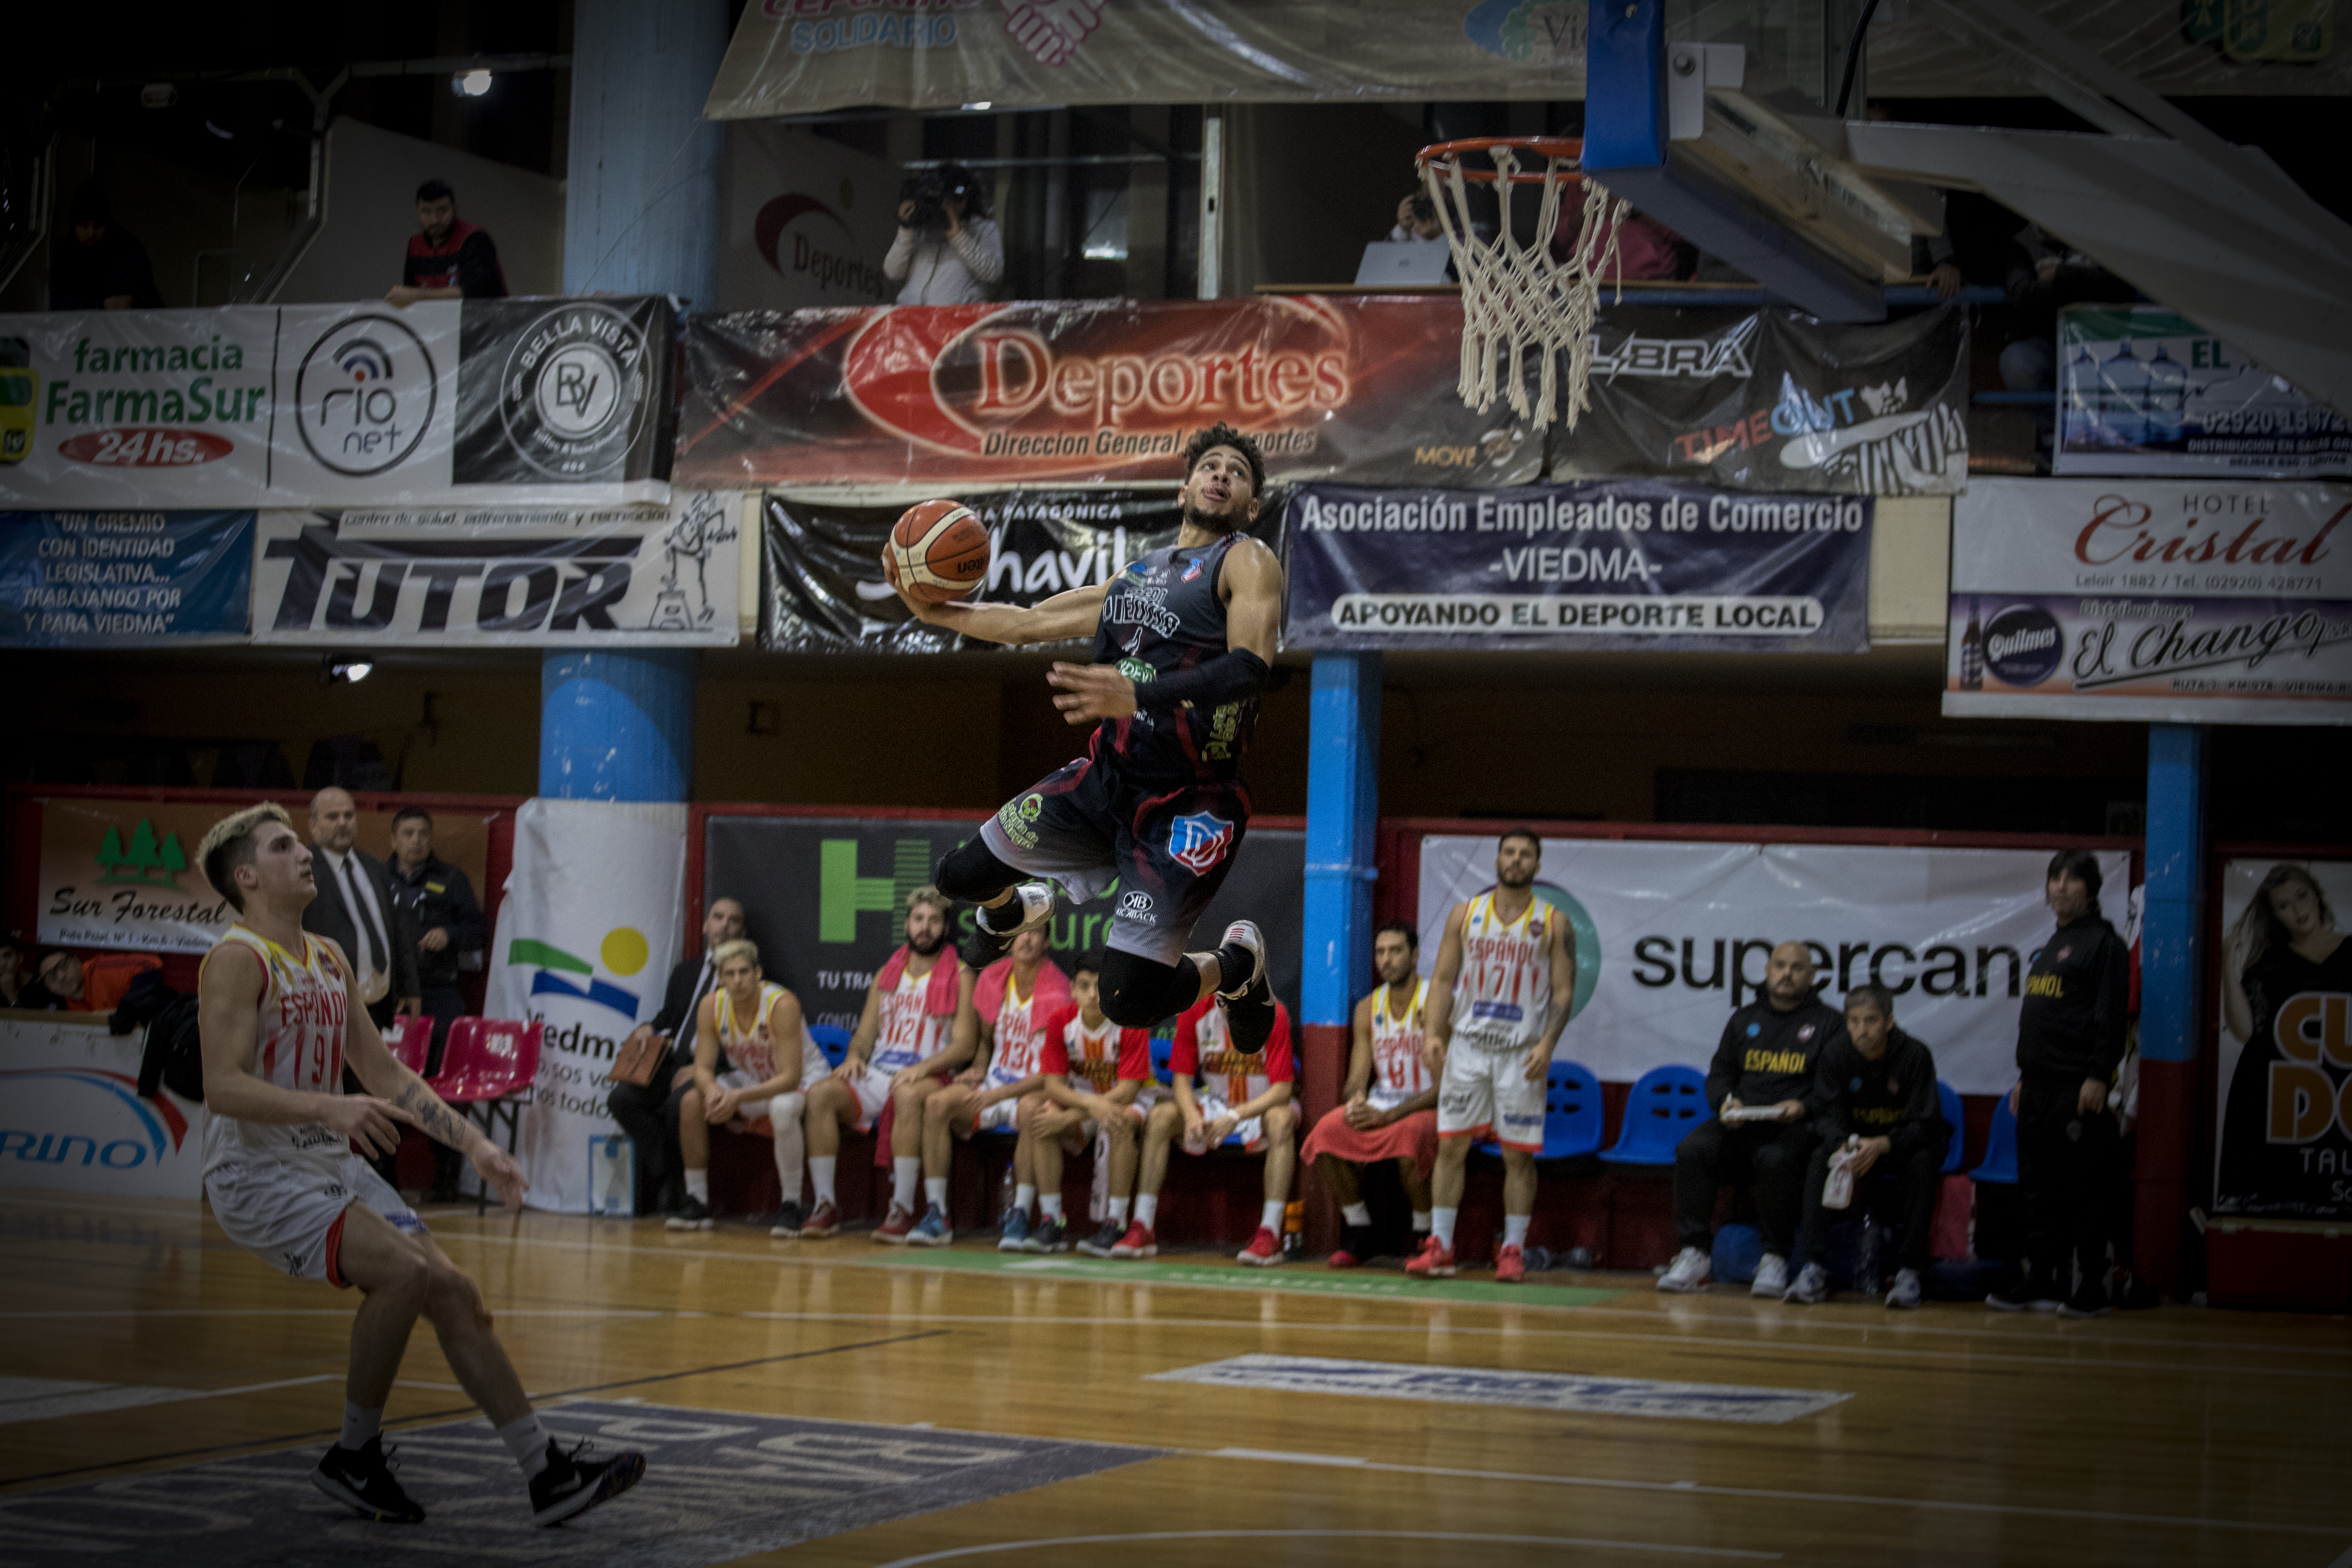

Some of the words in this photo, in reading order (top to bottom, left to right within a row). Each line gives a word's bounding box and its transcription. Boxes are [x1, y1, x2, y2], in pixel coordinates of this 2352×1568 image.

[792, 12, 956, 55] SOLIDARIO
[794, 232, 883, 299] Deportes
[74, 337, 243, 374] farmacia
[520, 315, 583, 369] BELLA
[591, 315, 638, 368] VISTA
[2192, 340, 2230, 369] EL
[556, 363, 600, 418] BV
[976, 329, 1351, 426] Deportes
[44, 378, 265, 426] FarmaSur
[320, 387, 397, 427] rio
[343, 424, 402, 455] net
[2201, 411, 2274, 435] 02920
[985, 431, 1089, 456] Direccion
[1095, 429, 1181, 454] General
[1413, 445, 1477, 468] MOVE
[1300, 495, 1472, 531] Asociación
[1476, 495, 1652, 538] Empleados
[1660, 495, 1699, 531] de
[1708, 495, 1864, 532] Comercio
[2183, 495, 2271, 514] HOTEL
[94, 513, 165, 533] GREMIO
[2075, 493, 2352, 565] Cristal
[38, 537, 76, 557] CON
[82, 537, 175, 558] IDENTIDAD
[23, 588, 139, 608] TRABAJANDO
[146, 588, 182, 608] POR
[264, 537, 638, 632] TUTOR
[2075, 574, 2115, 589] Leloir
[2121, 575, 2155, 589] 1882
[2174, 575, 2199, 590] Tel.
[2206, 575, 2262, 591] (02920)
[23, 612, 37, 632] Y
[41, 612, 88, 632] PARA
[1339, 601, 1501, 627] APOYANDO
[1511, 602, 1548, 627] EL
[1557, 603, 1706, 628] DEPORTE
[1716, 604, 1818, 629] LOCAL
[1988, 626, 2057, 662] Quilmes
[2073, 619, 2119, 680] El
[2130, 608, 2325, 669] Chango
[49, 887, 103, 916] Sur
[112, 890, 228, 925] Forestal
[816, 970, 841, 991] TU
[1493, 965, 1506, 997] 7
[1631, 935, 2035, 1007] supercan
[312, 1034, 325, 1085] 9
[561, 1091, 614, 1121] todo
